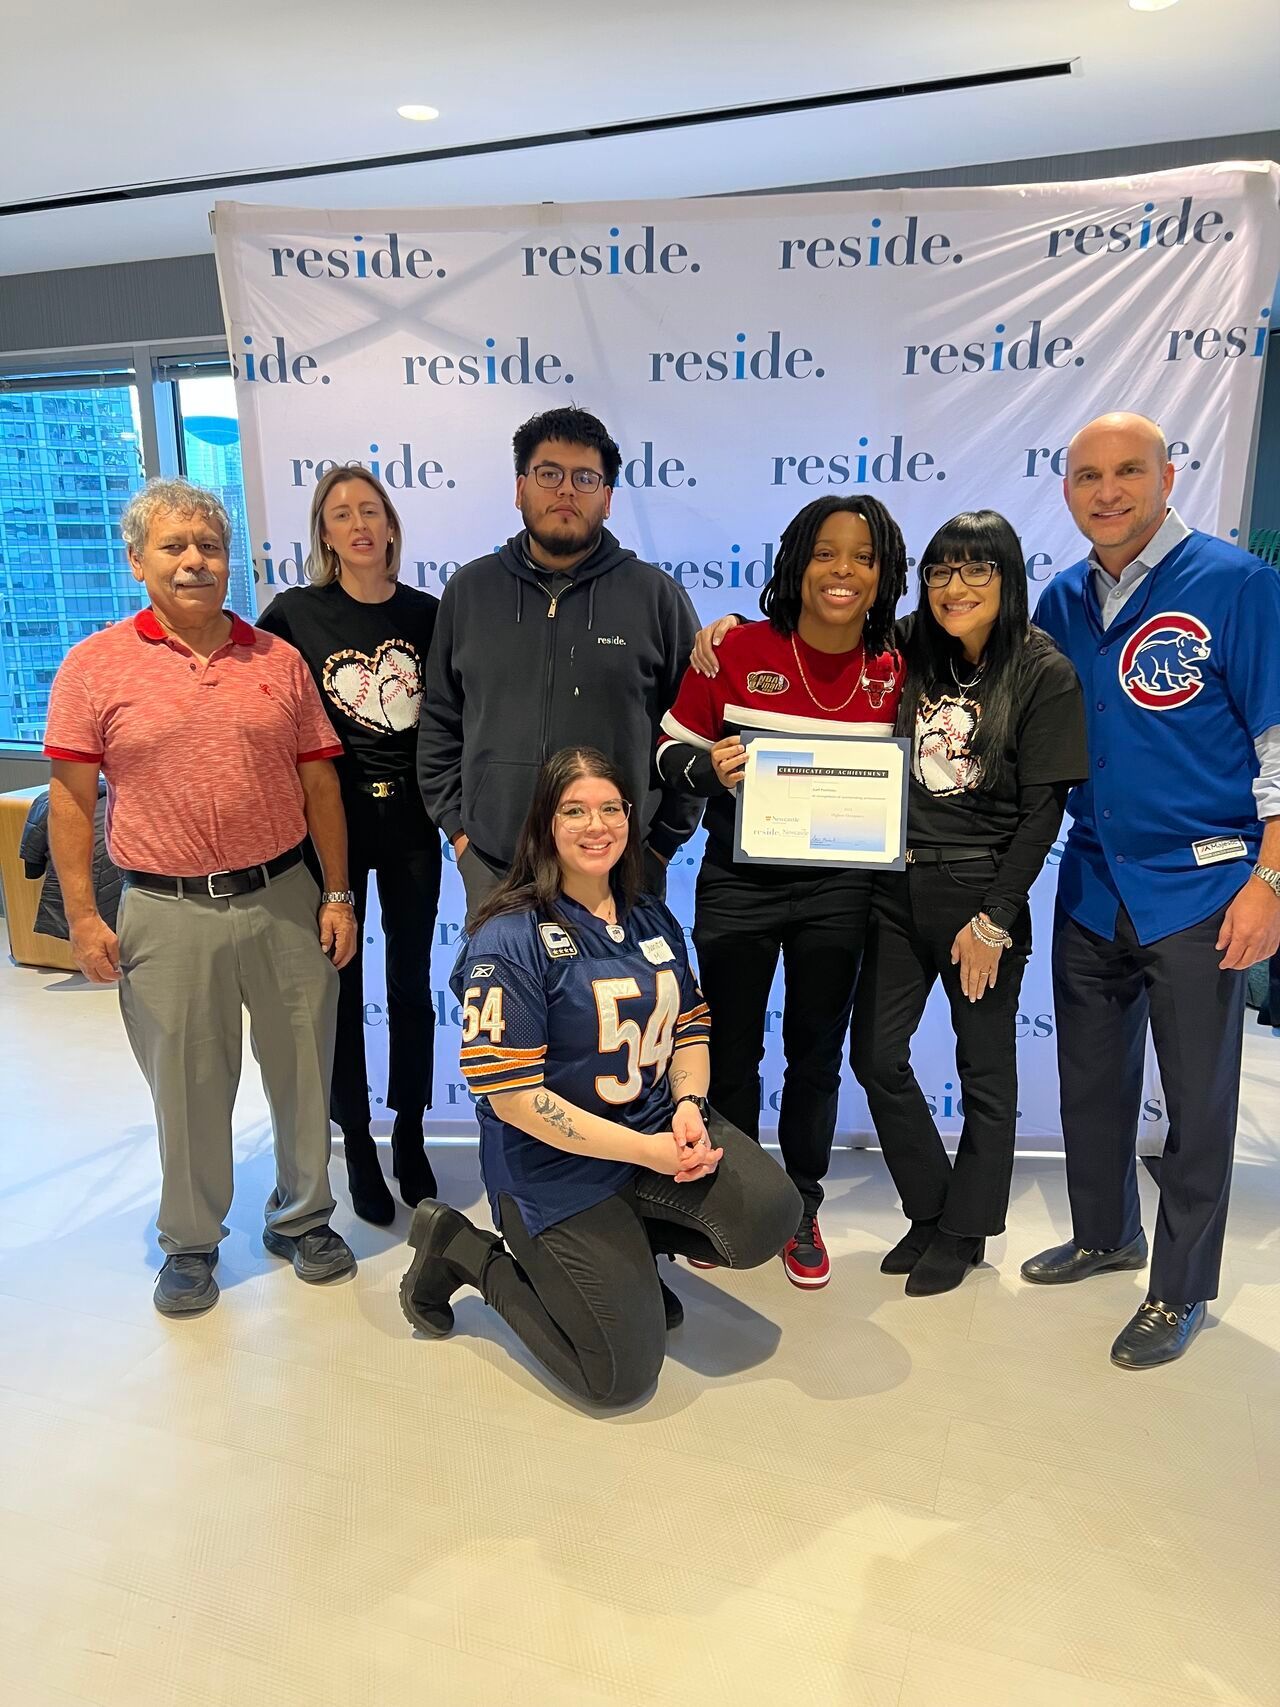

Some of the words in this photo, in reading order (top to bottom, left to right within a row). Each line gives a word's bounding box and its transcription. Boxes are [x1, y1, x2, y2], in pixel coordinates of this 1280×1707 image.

[521, 225, 701, 277] reside.
[778, 216, 963, 270] reside.
[1044, 197, 1234, 259] reside.
[268, 233, 446, 280] reside.
[648, 331, 825, 383] reside.
[902, 320, 1085, 377] reside.
[1163, 307, 1270, 361] resi
[402, 337, 575, 386] reside.
[770, 436, 946, 486] reside.
[597, 635, 627, 646] reside.
[778, 767, 822, 775] CERTIFICATE
[462, 986, 505, 1043] 54
[592, 969, 681, 1105] 54
